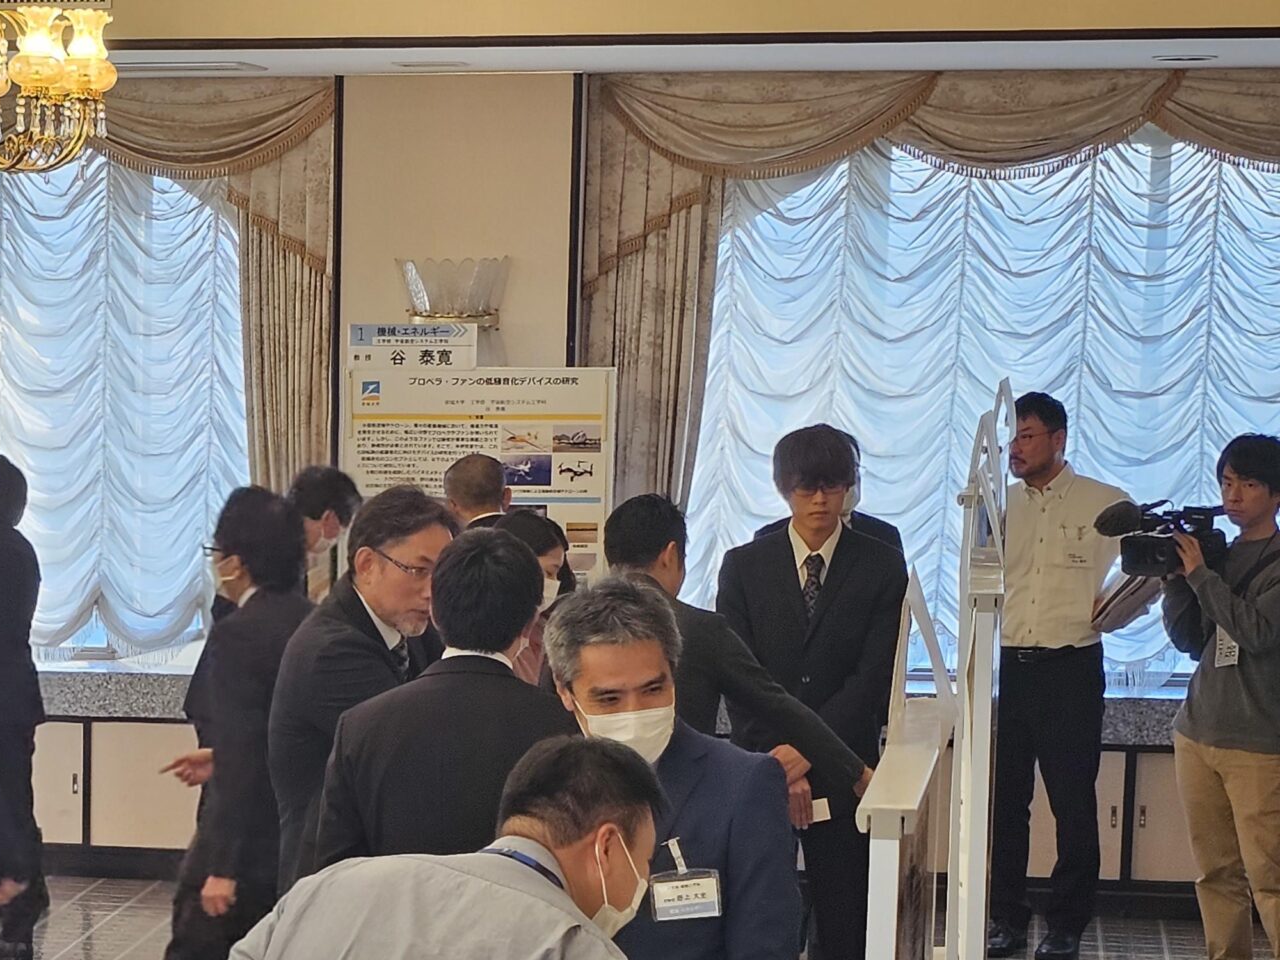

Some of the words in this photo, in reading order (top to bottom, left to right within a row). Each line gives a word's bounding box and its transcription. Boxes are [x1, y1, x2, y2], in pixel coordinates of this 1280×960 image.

[357, 327, 365, 341] 1
[377, 326, 450, 337] 機械・エネルギー
[390, 349, 406, 365] 谷
[418, 349, 453, 366] 泰寛
